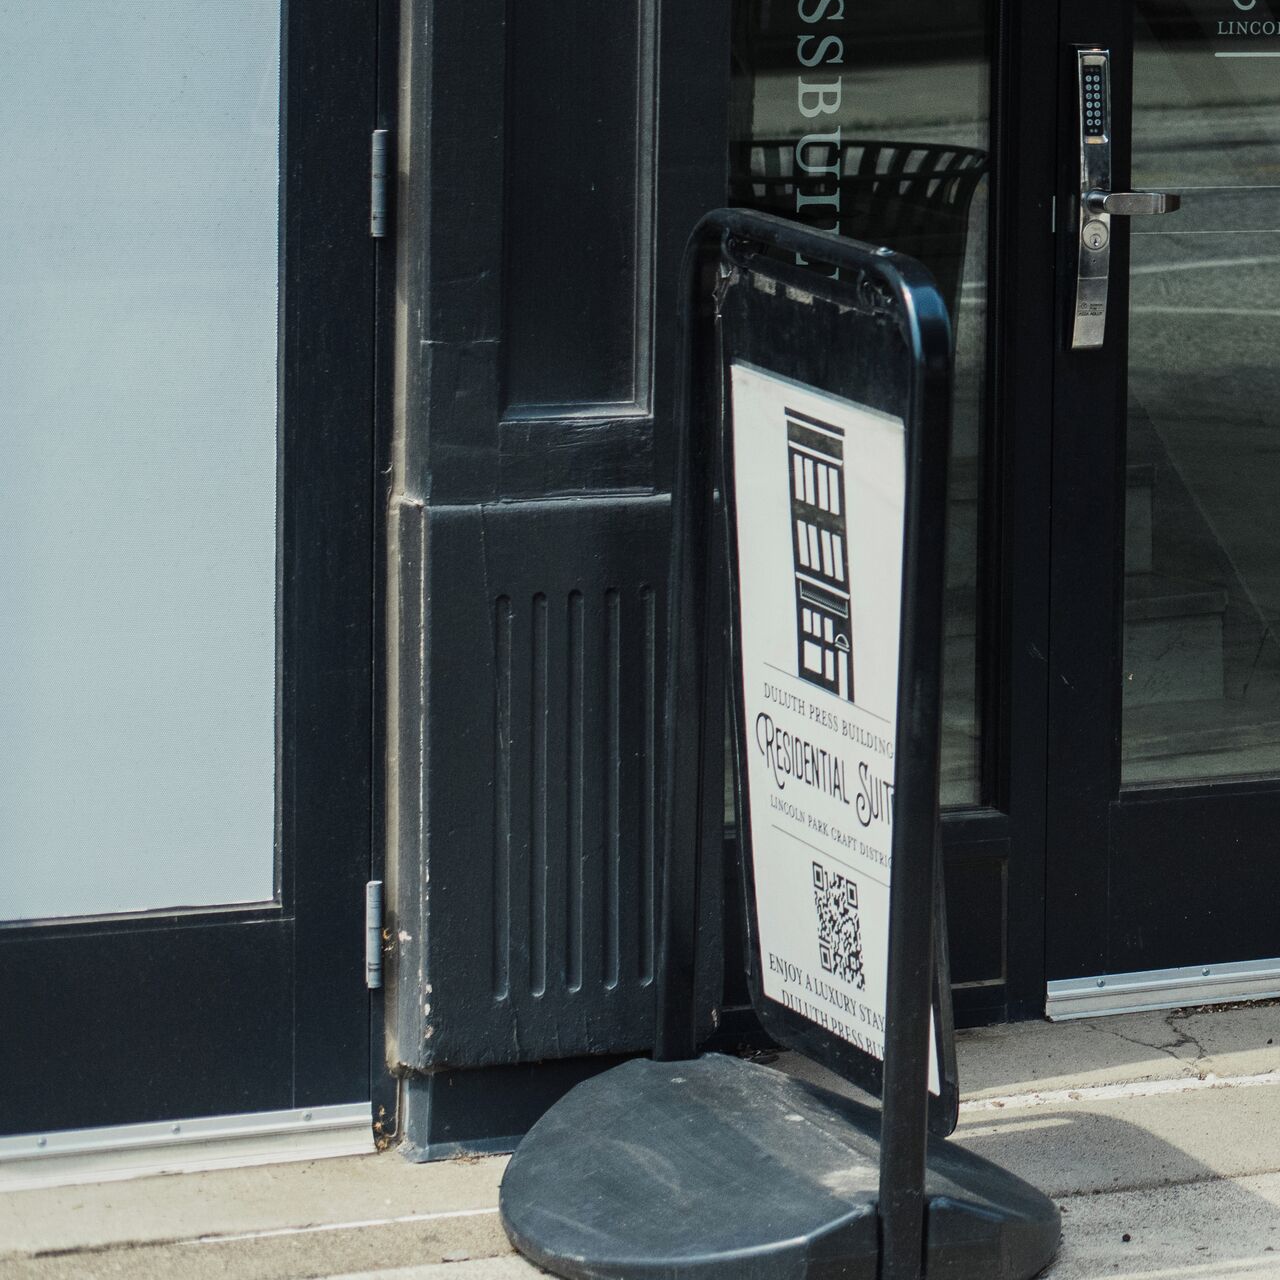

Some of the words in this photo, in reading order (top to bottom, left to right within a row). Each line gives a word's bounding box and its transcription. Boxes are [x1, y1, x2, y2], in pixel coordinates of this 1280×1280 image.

[763, 682, 806, 717] DULUTH
[809, 704, 839, 733] PRESS
[756, 712, 850, 805] RESIDENTIAL
[770, 794, 806, 824] LINCOLN
[808, 814, 830, 838] PARK
[831, 827, 858, 852] CRAFT
[769, 952, 802, 986] ENJOY
[805, 974, 813, 992] A
[814, 978, 857, 1017] LUXURY
[859, 1003, 885, 1033] STAY
[782, 989, 829, 1029] DULUTH
[831, 1017, 864, 1050] PRESS
